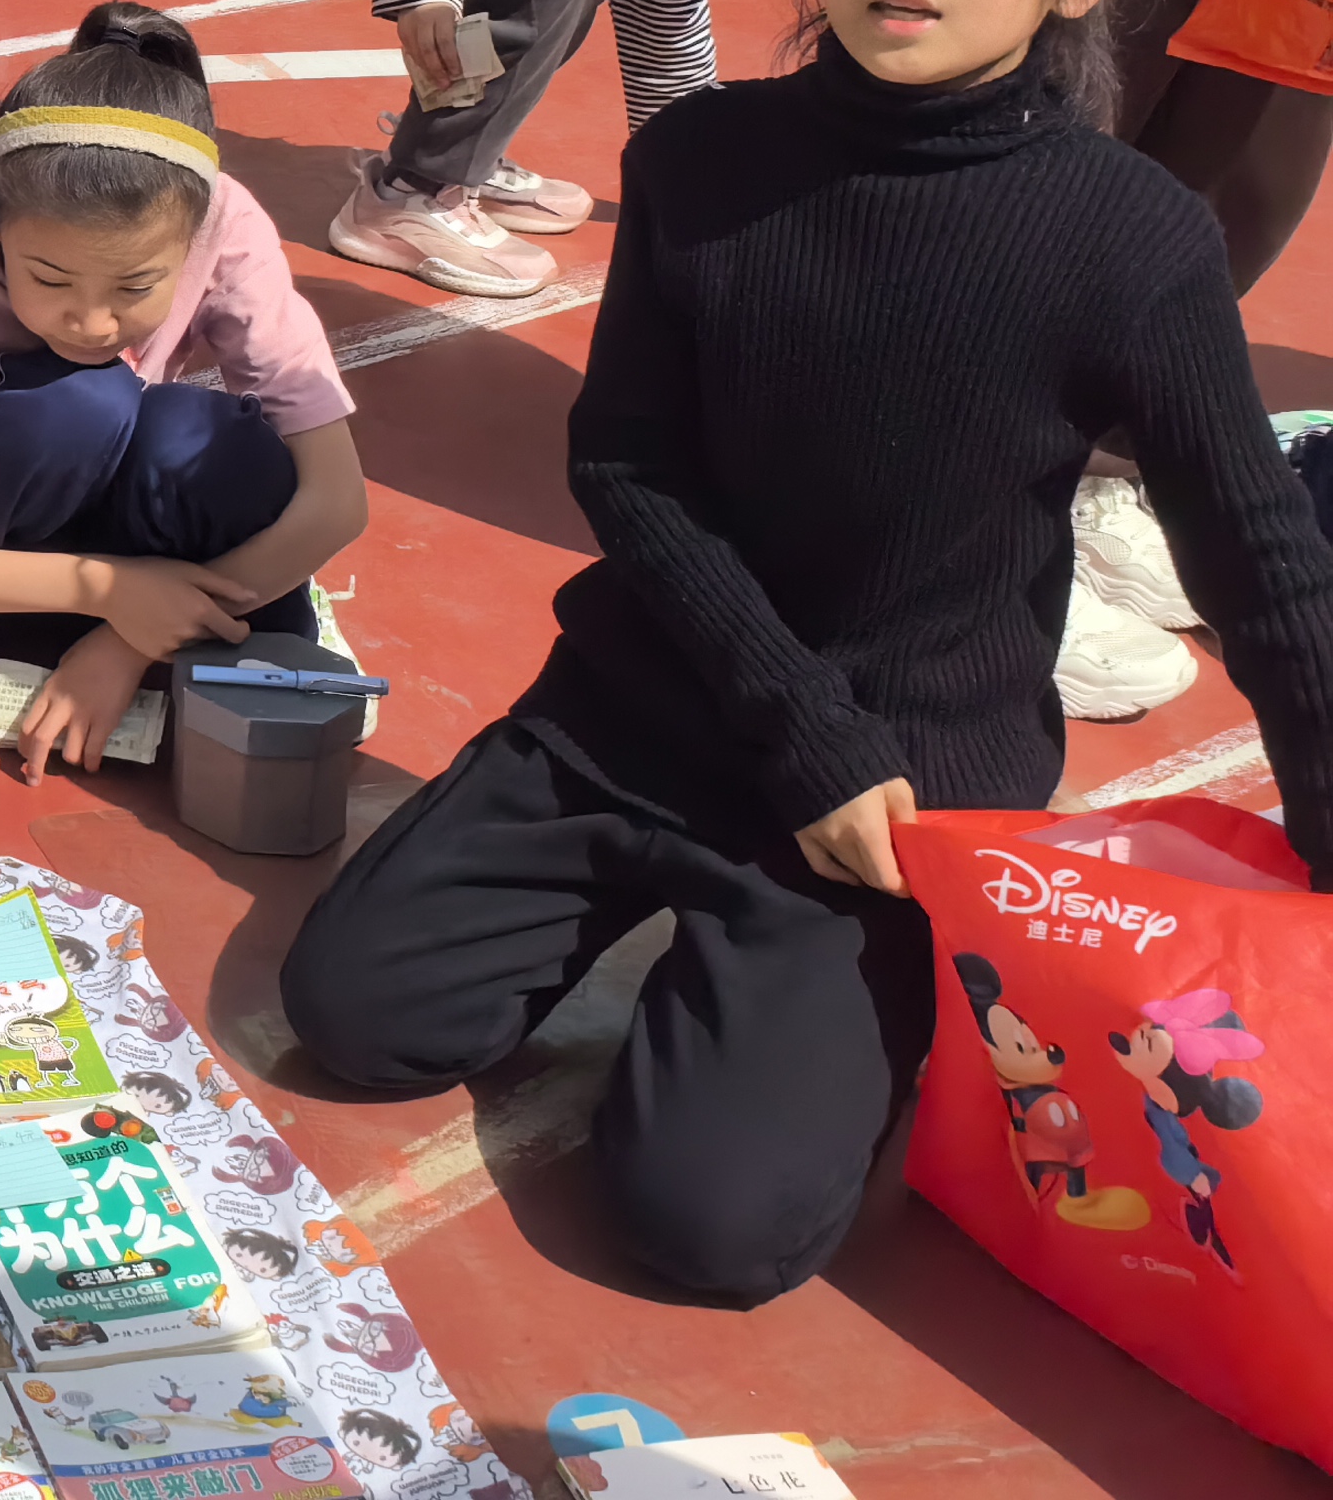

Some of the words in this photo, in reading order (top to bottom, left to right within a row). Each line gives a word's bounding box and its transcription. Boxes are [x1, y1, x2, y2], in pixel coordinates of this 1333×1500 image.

[1026, 918, 1103, 949] 迪士尼
[32, 1280, 169, 1313] KNOWLEDGE
[174, 1270, 220, 1292] FOR
[89, 1462, 264, 1500] 狐狸来敲门
